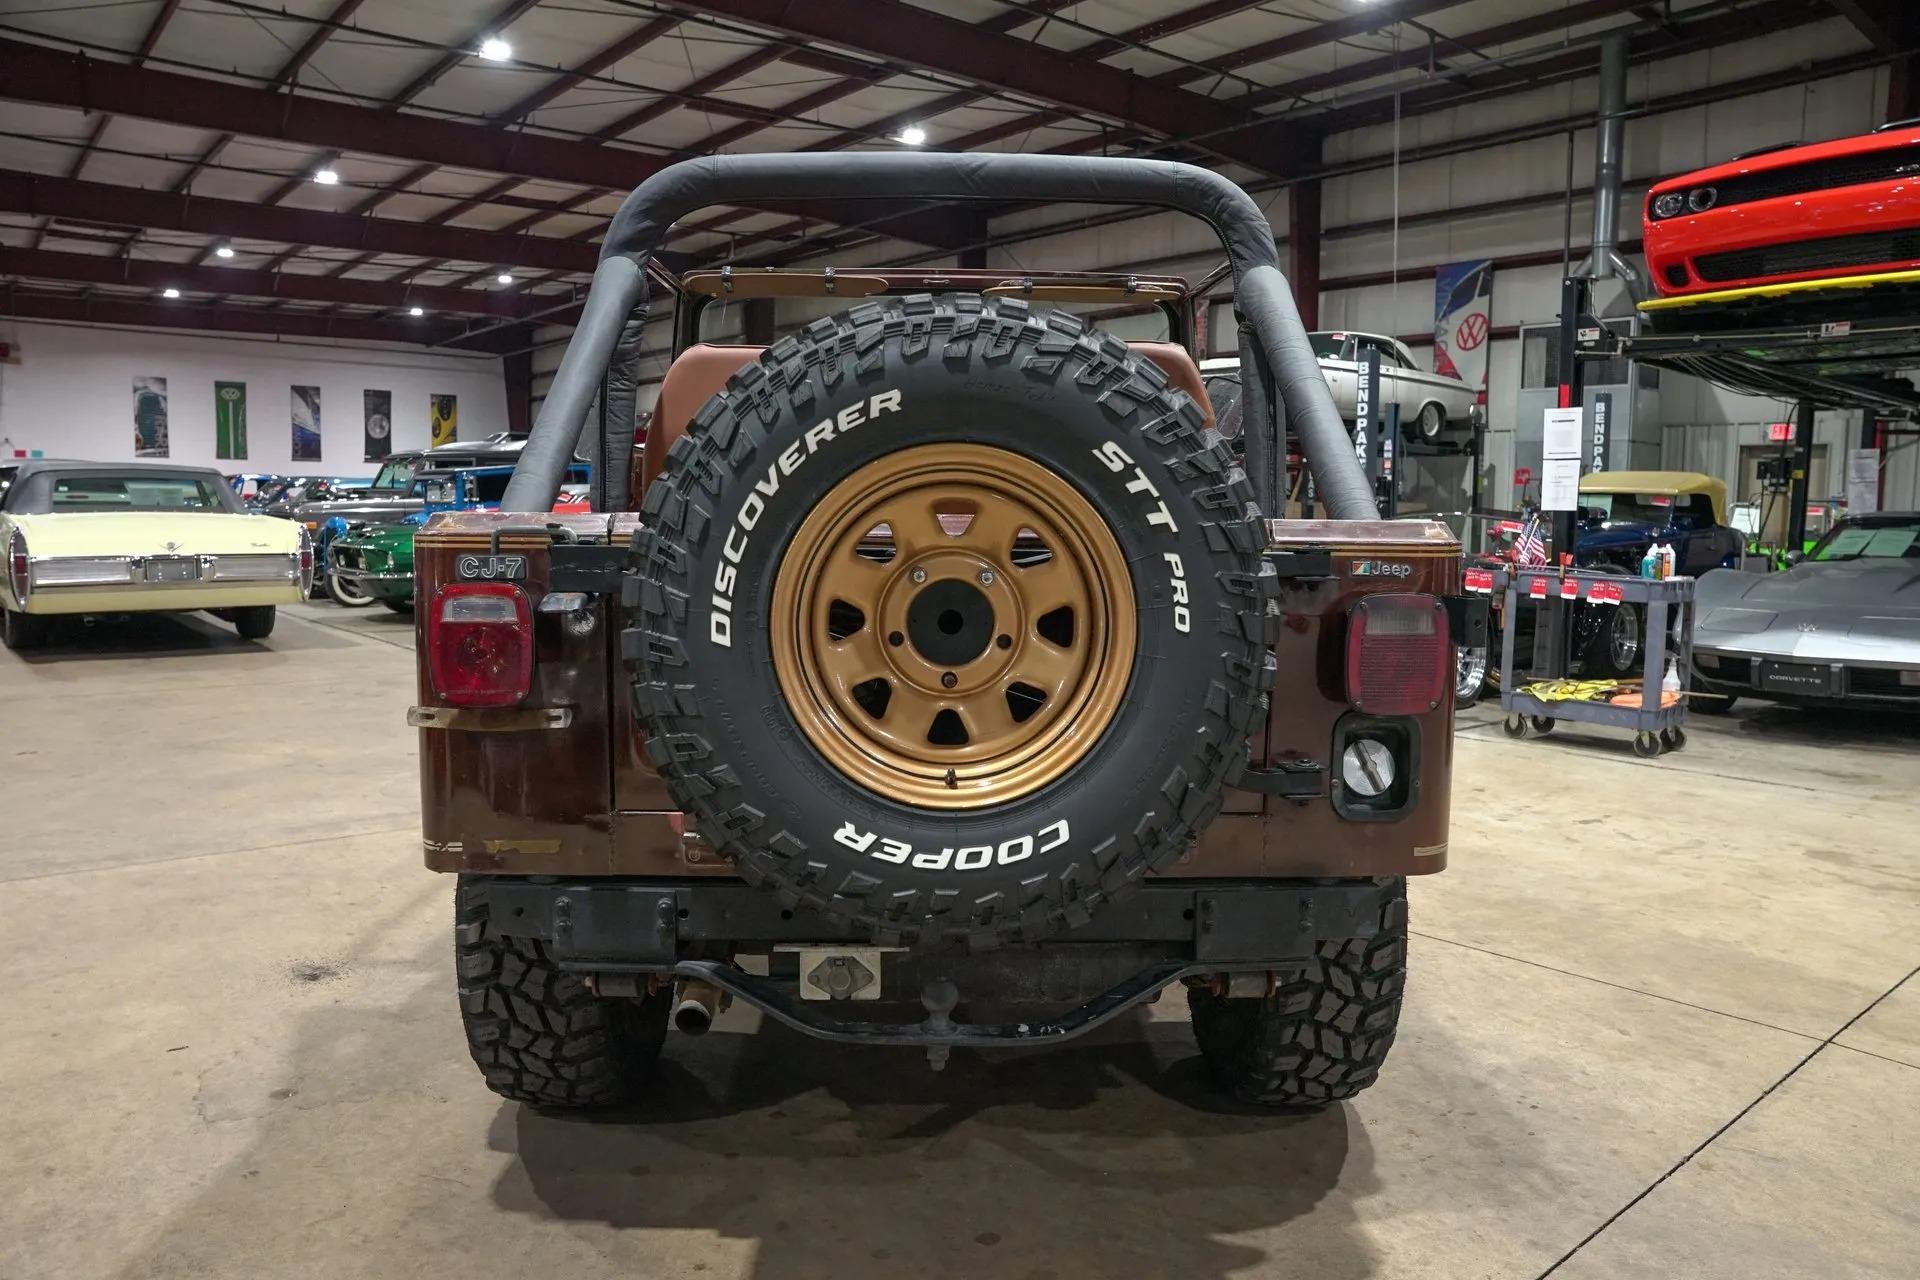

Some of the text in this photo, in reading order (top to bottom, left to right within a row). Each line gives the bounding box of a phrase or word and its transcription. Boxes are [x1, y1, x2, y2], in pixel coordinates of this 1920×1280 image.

[1355, 361, 1370, 458] BENDPAK
[710, 389, 902, 648] DISCOVERER
[1092, 440, 1190, 633] STT PRO
[460, 556, 522, 579] CJ-7
[1371, 560, 1411, 579] Jeep
[833, 819, 1070, 871] COOPER
